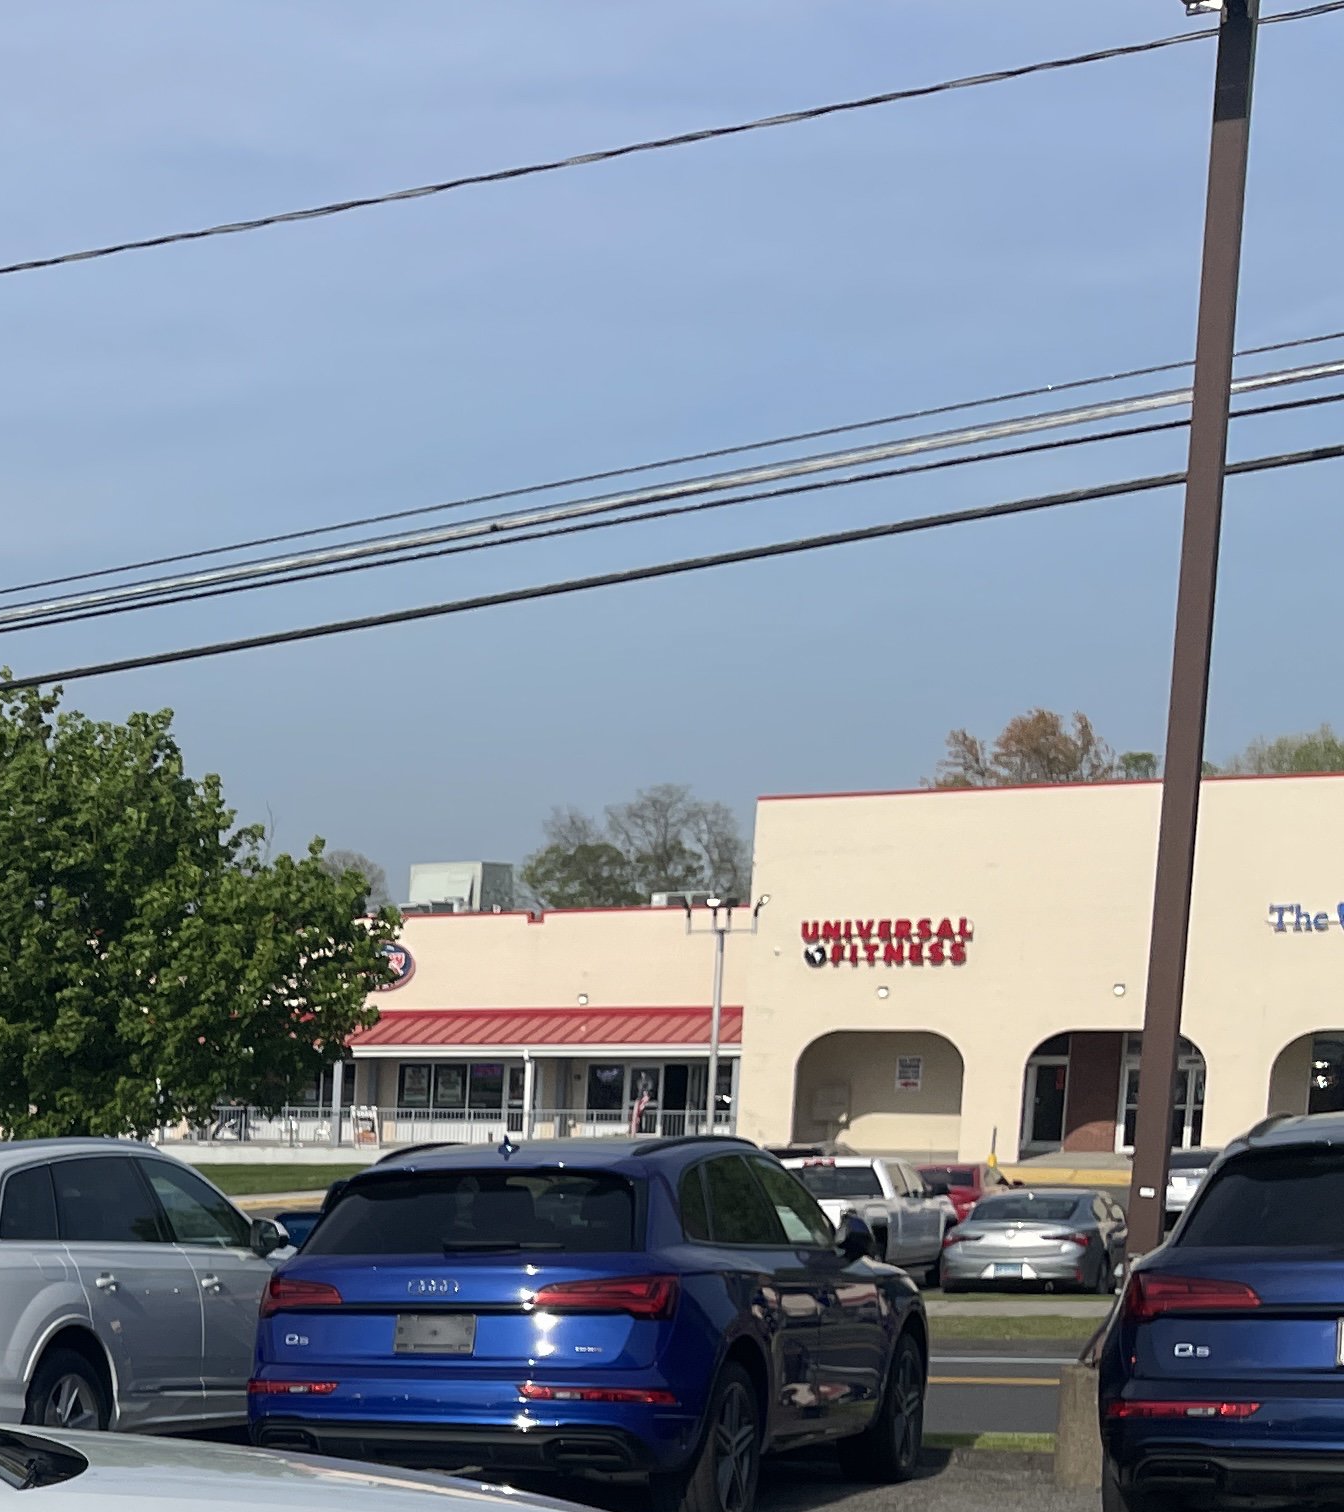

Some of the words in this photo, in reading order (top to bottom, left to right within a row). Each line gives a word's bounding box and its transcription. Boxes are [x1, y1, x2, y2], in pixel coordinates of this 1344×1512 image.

[801, 917, 974, 945] UNIVERSAL
[1269, 903, 1329, 932] The
[830, 942, 967, 968] FITNESS
